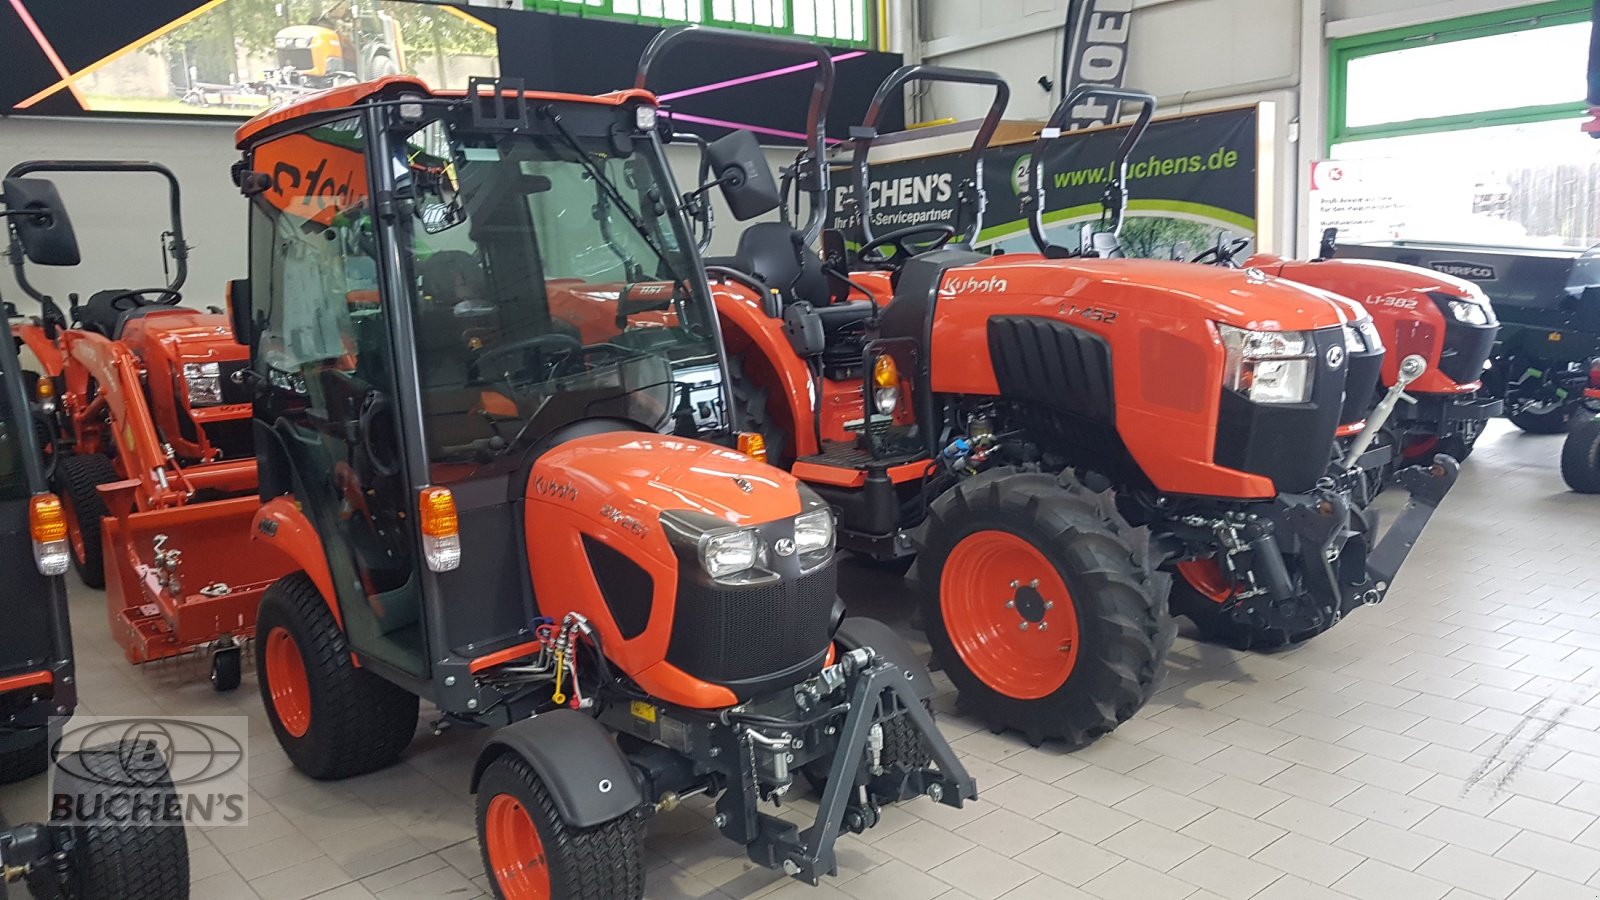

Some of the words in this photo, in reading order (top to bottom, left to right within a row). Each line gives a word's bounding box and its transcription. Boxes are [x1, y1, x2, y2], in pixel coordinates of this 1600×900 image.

[834, 173, 953, 213] BCHEN'S
[1435, 264, 1491, 278] TURFCO
[938, 275, 1008, 299] Kubota
[535, 474, 578, 502] Kubota
